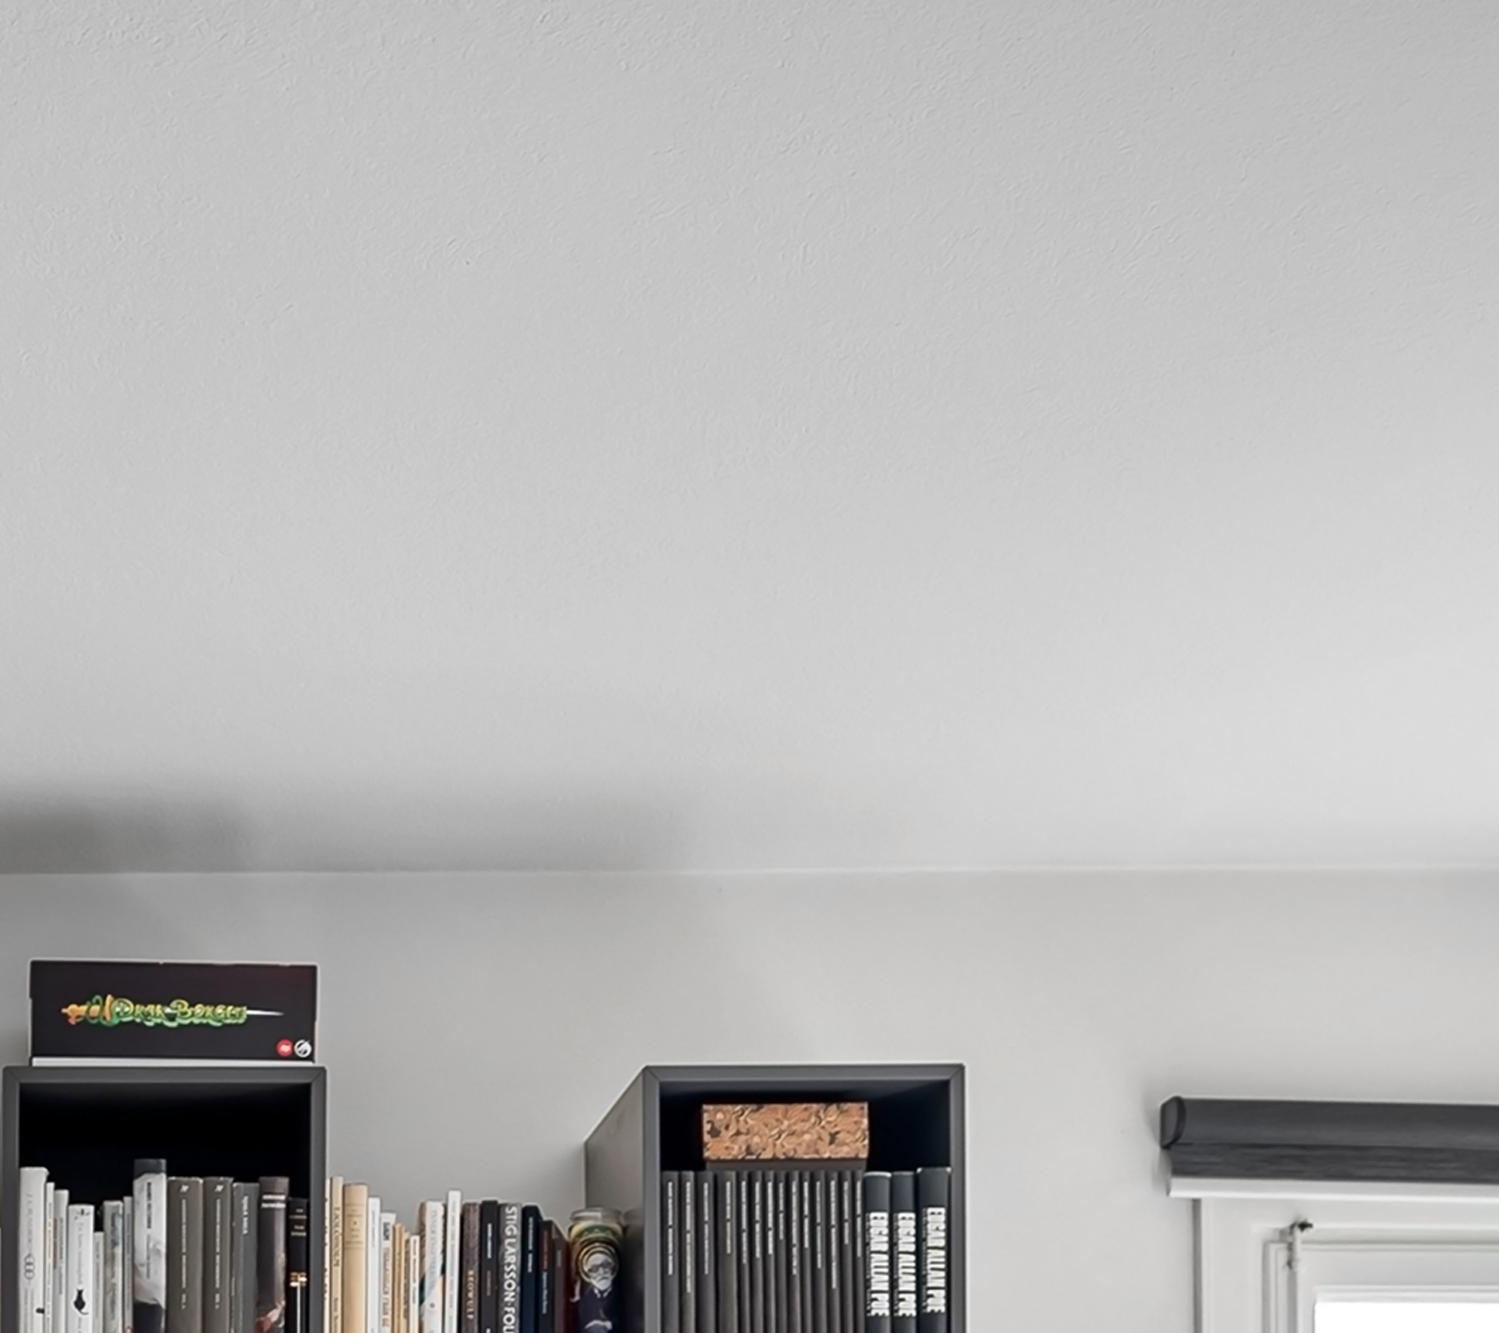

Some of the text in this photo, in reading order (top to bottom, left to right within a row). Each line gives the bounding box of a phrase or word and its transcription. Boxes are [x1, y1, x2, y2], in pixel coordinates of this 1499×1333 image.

[504, 1206, 517, 1236] STIG
[926, 1207, 946, 1313] EDGAR ALLAN POE
[466, 1269, 475, 1321] BEOWULF
[504, 1238, 516, 1302] LARSSON
[869, 1212, 889, 1317] EDGAR ALLAN POE
[897, 1212, 916, 1317] EDGAR ALLAN POE
